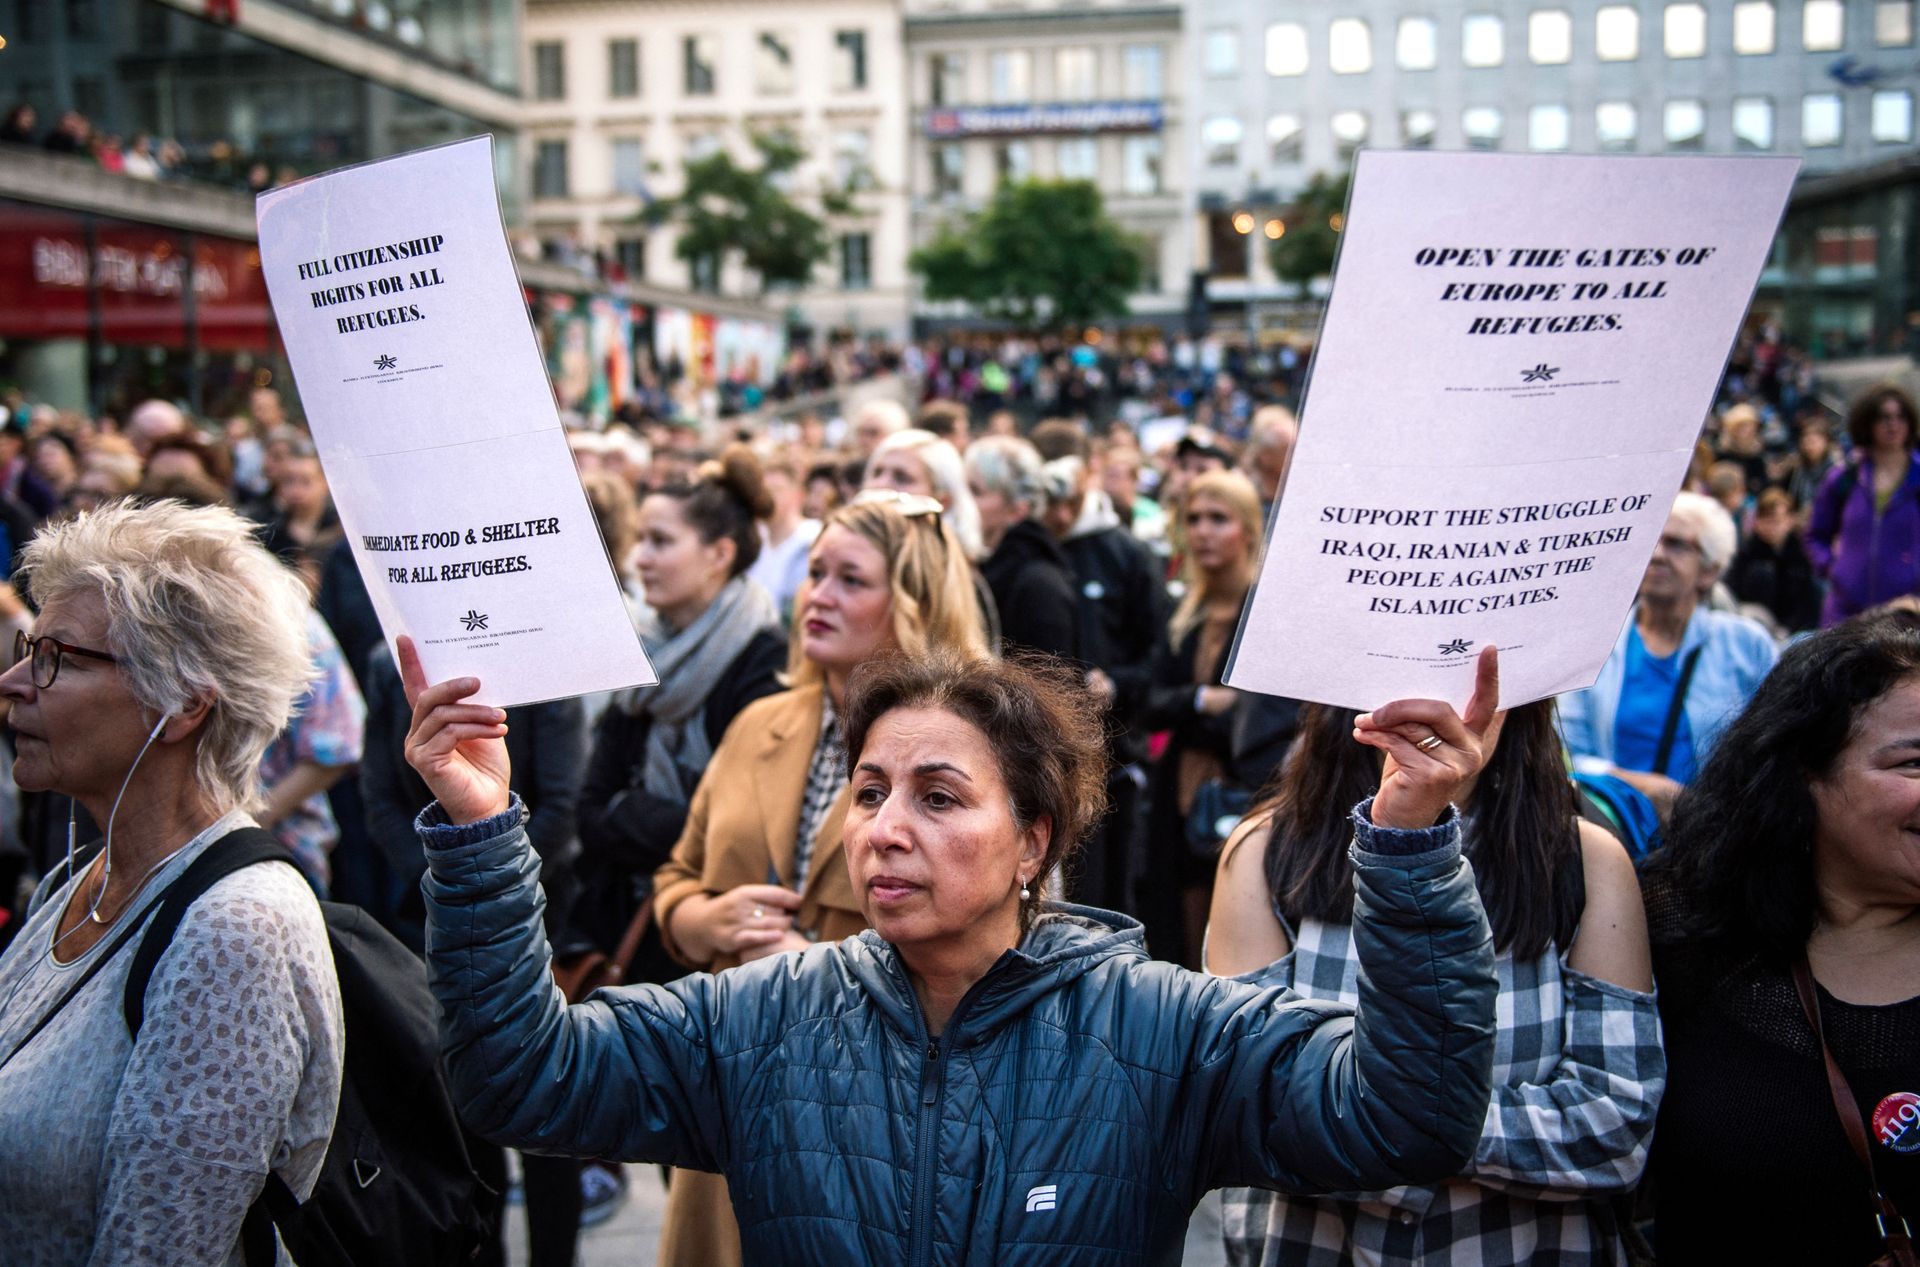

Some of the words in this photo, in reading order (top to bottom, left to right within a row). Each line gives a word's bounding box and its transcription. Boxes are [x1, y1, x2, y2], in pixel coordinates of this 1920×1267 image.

[297, 258, 333, 281] FULL
[333, 234, 445, 273] CITIZENSHIP
[1414, 247, 1502, 267] OPEN
[1507, 248, 1571, 268] THE
[1575, 248, 1671, 268] GATES
[1675, 246, 1717, 266] OF
[310, 282, 366, 309] RIGHTS
[366, 275, 405, 298] FOR
[409, 267, 445, 290] ALL
[1440, 282, 1567, 302] EUROPE
[1571, 282, 1610, 301] TO
[1612, 280, 1667, 300] ALL
[335, 303, 426, 335] REFUGEES.
[1467, 313, 1623, 335] REFUGEES.
[1320, 506, 1439, 527] SUPPORT
[1444, 508, 1494, 527] THE
[1495, 497, 1618, 525] STRUGGLE
[1620, 493, 1653, 513] OF
[361, 534, 420, 552] IMMEDIATE
[421, 530, 461, 551] FOOD
[464, 528, 478, 546] &
[481, 516, 561, 544] SHELTER
[1320, 538, 1402, 562] IRAQI,
[1407, 540, 1511, 560] IRANIAN
[1513, 538, 1532, 555] &
[1538, 526, 1633, 553] TURKISH
[387, 567, 410, 585] FOR
[410, 565, 439, 584] ALL
[440, 554, 533, 583] REFUGEES.
[1346, 568, 1445, 588] PEOPLE
[1448, 562, 1550, 588] AGAINST
[1553, 555, 1596, 576] THE
[1368, 596, 1474, 615] ISLAMIC
[1476, 586, 1559, 613] STATES.
[1880, 1103, 1920, 1143] 119
